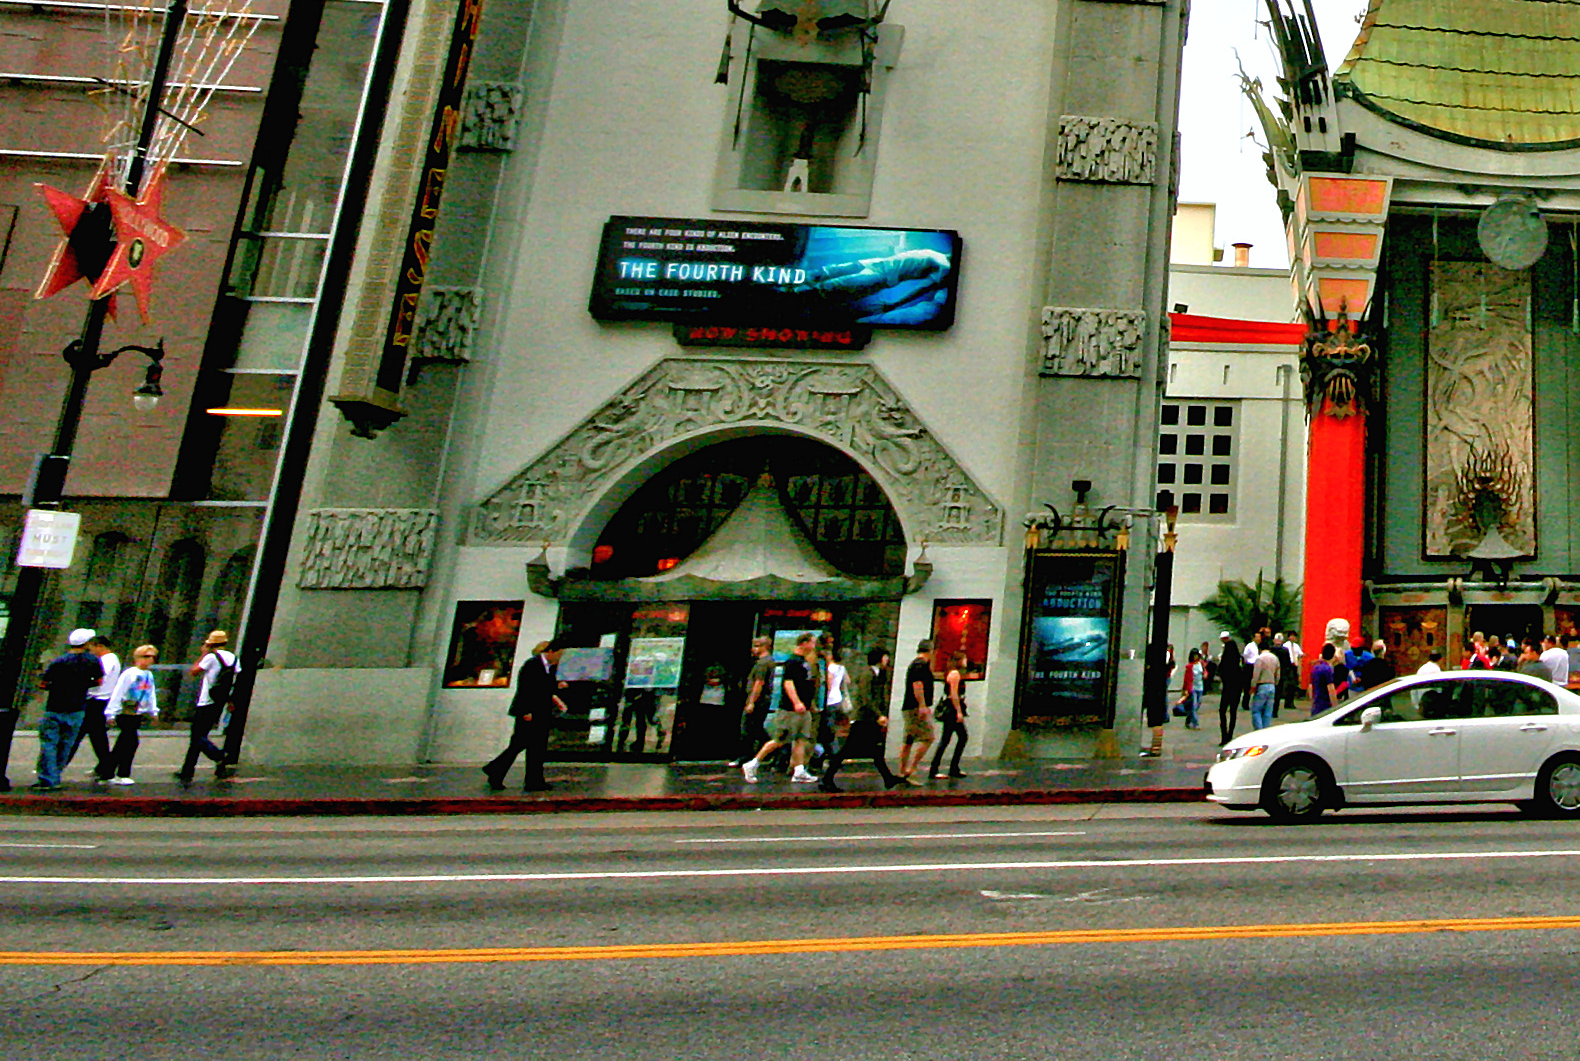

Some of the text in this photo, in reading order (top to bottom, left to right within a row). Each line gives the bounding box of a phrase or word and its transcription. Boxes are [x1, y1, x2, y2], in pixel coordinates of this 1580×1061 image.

[619, 261, 807, 284] THE FOURTH KIND
